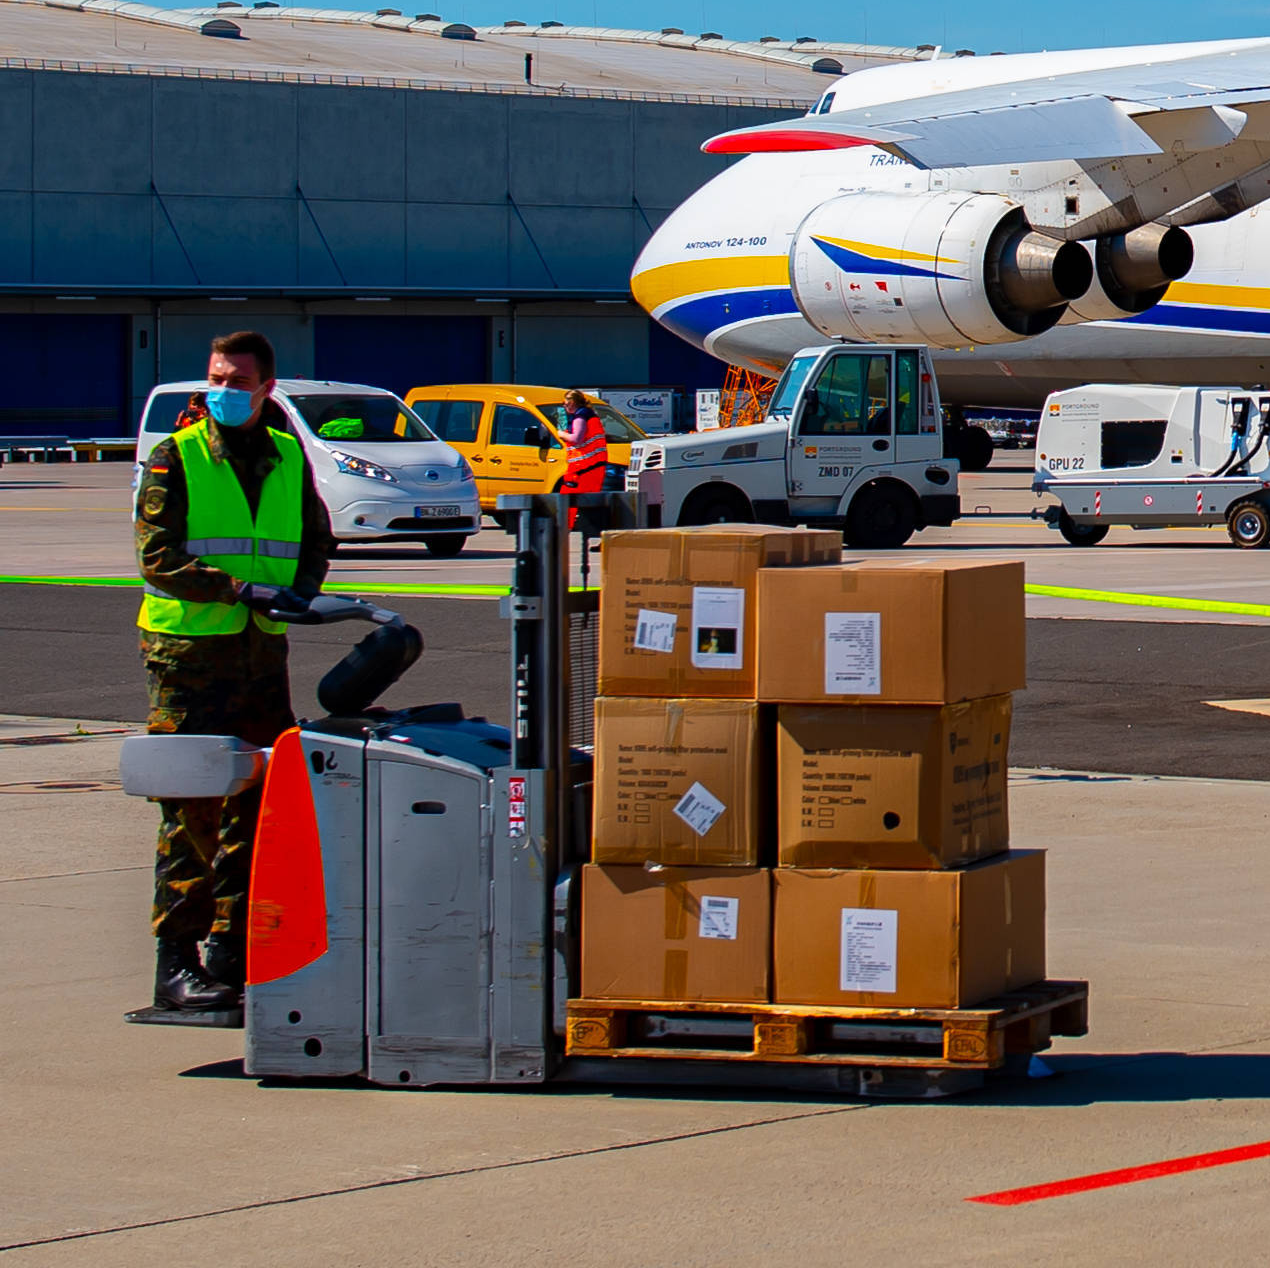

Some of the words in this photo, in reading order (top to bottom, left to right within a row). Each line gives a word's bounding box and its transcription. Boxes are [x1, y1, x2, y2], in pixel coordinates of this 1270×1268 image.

[685, 240, 723, 250] ANTONOV
[726, 236, 767, 247] 124-100
[1049, 458, 1070, 470] GPU
[1072, 457, 1085, 470] 22
[818, 466, 840, 477] ZMD
[842, 466, 854, 477] 07
[516, 654, 529, 739] STILL
